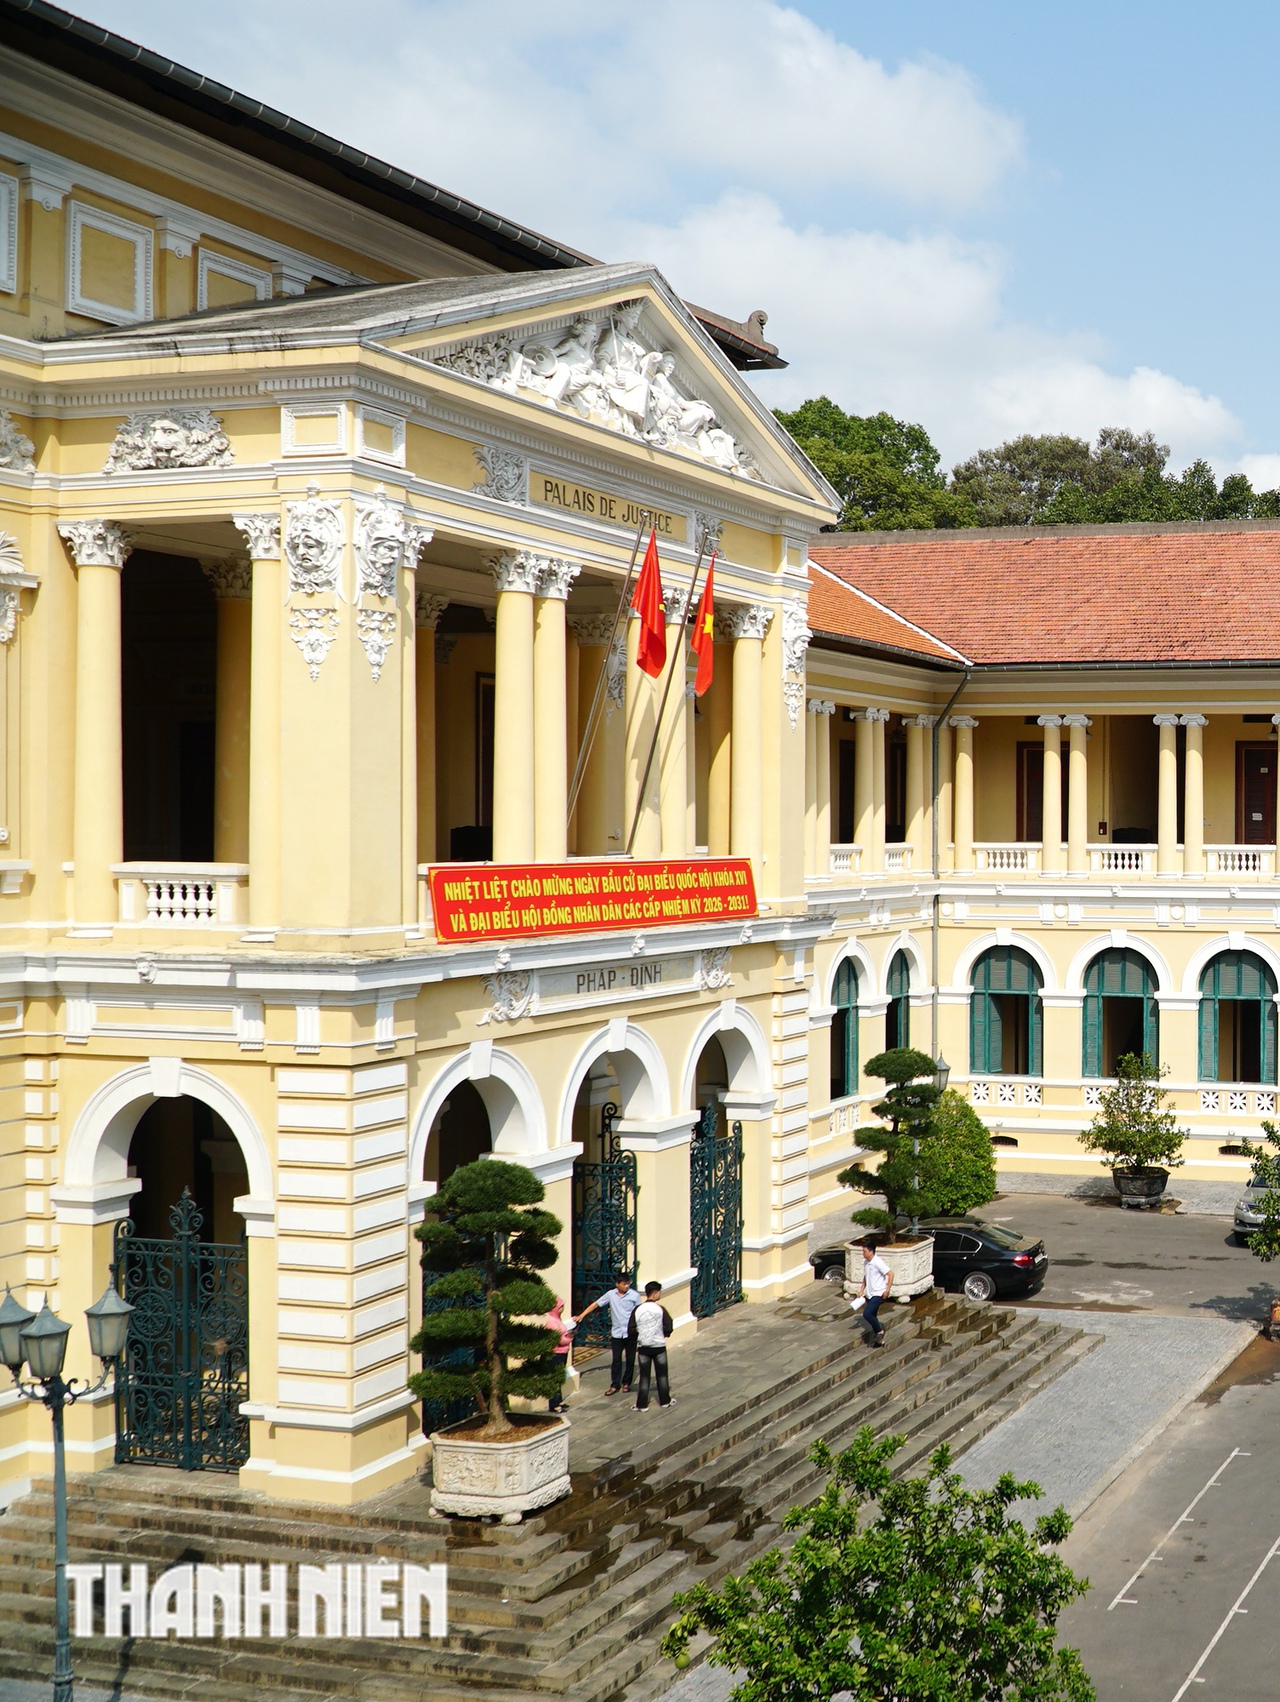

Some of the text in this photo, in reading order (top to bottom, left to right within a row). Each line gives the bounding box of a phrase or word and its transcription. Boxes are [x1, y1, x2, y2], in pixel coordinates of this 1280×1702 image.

[544, 480, 672, 534] PALAIS DE JUSTICE
[444, 866, 748, 904] NHIỆT LIỆT CHÀO MỪNG NGÀY BẦU CỬ ĐẠI BIỂU QUỐC HỘI KHÓA XVI
[450, 908, 468, 932] VÀ
[469, 911, 490, 934] ĐẠI
[492, 901, 520, 930] BIỂU
[521, 904, 542, 930] HỘI
[542, 900, 572, 926] ĐỒNG
[573, 901, 601, 924] NHÂN
[602, 900, 622, 922] DÂN
[623, 899, 642, 919] CÁC
[642, 895, 661, 918] CẤP
[662, 896, 690, 918] NHIỆM
[690, 894, 702, 914] KỲ
[703, 897, 722, 913] 2026
[728, 894, 750, 910] 2031!
[576, 968, 616, 994] PHÁP
[630, 964, 662, 986] ĐÌNH
